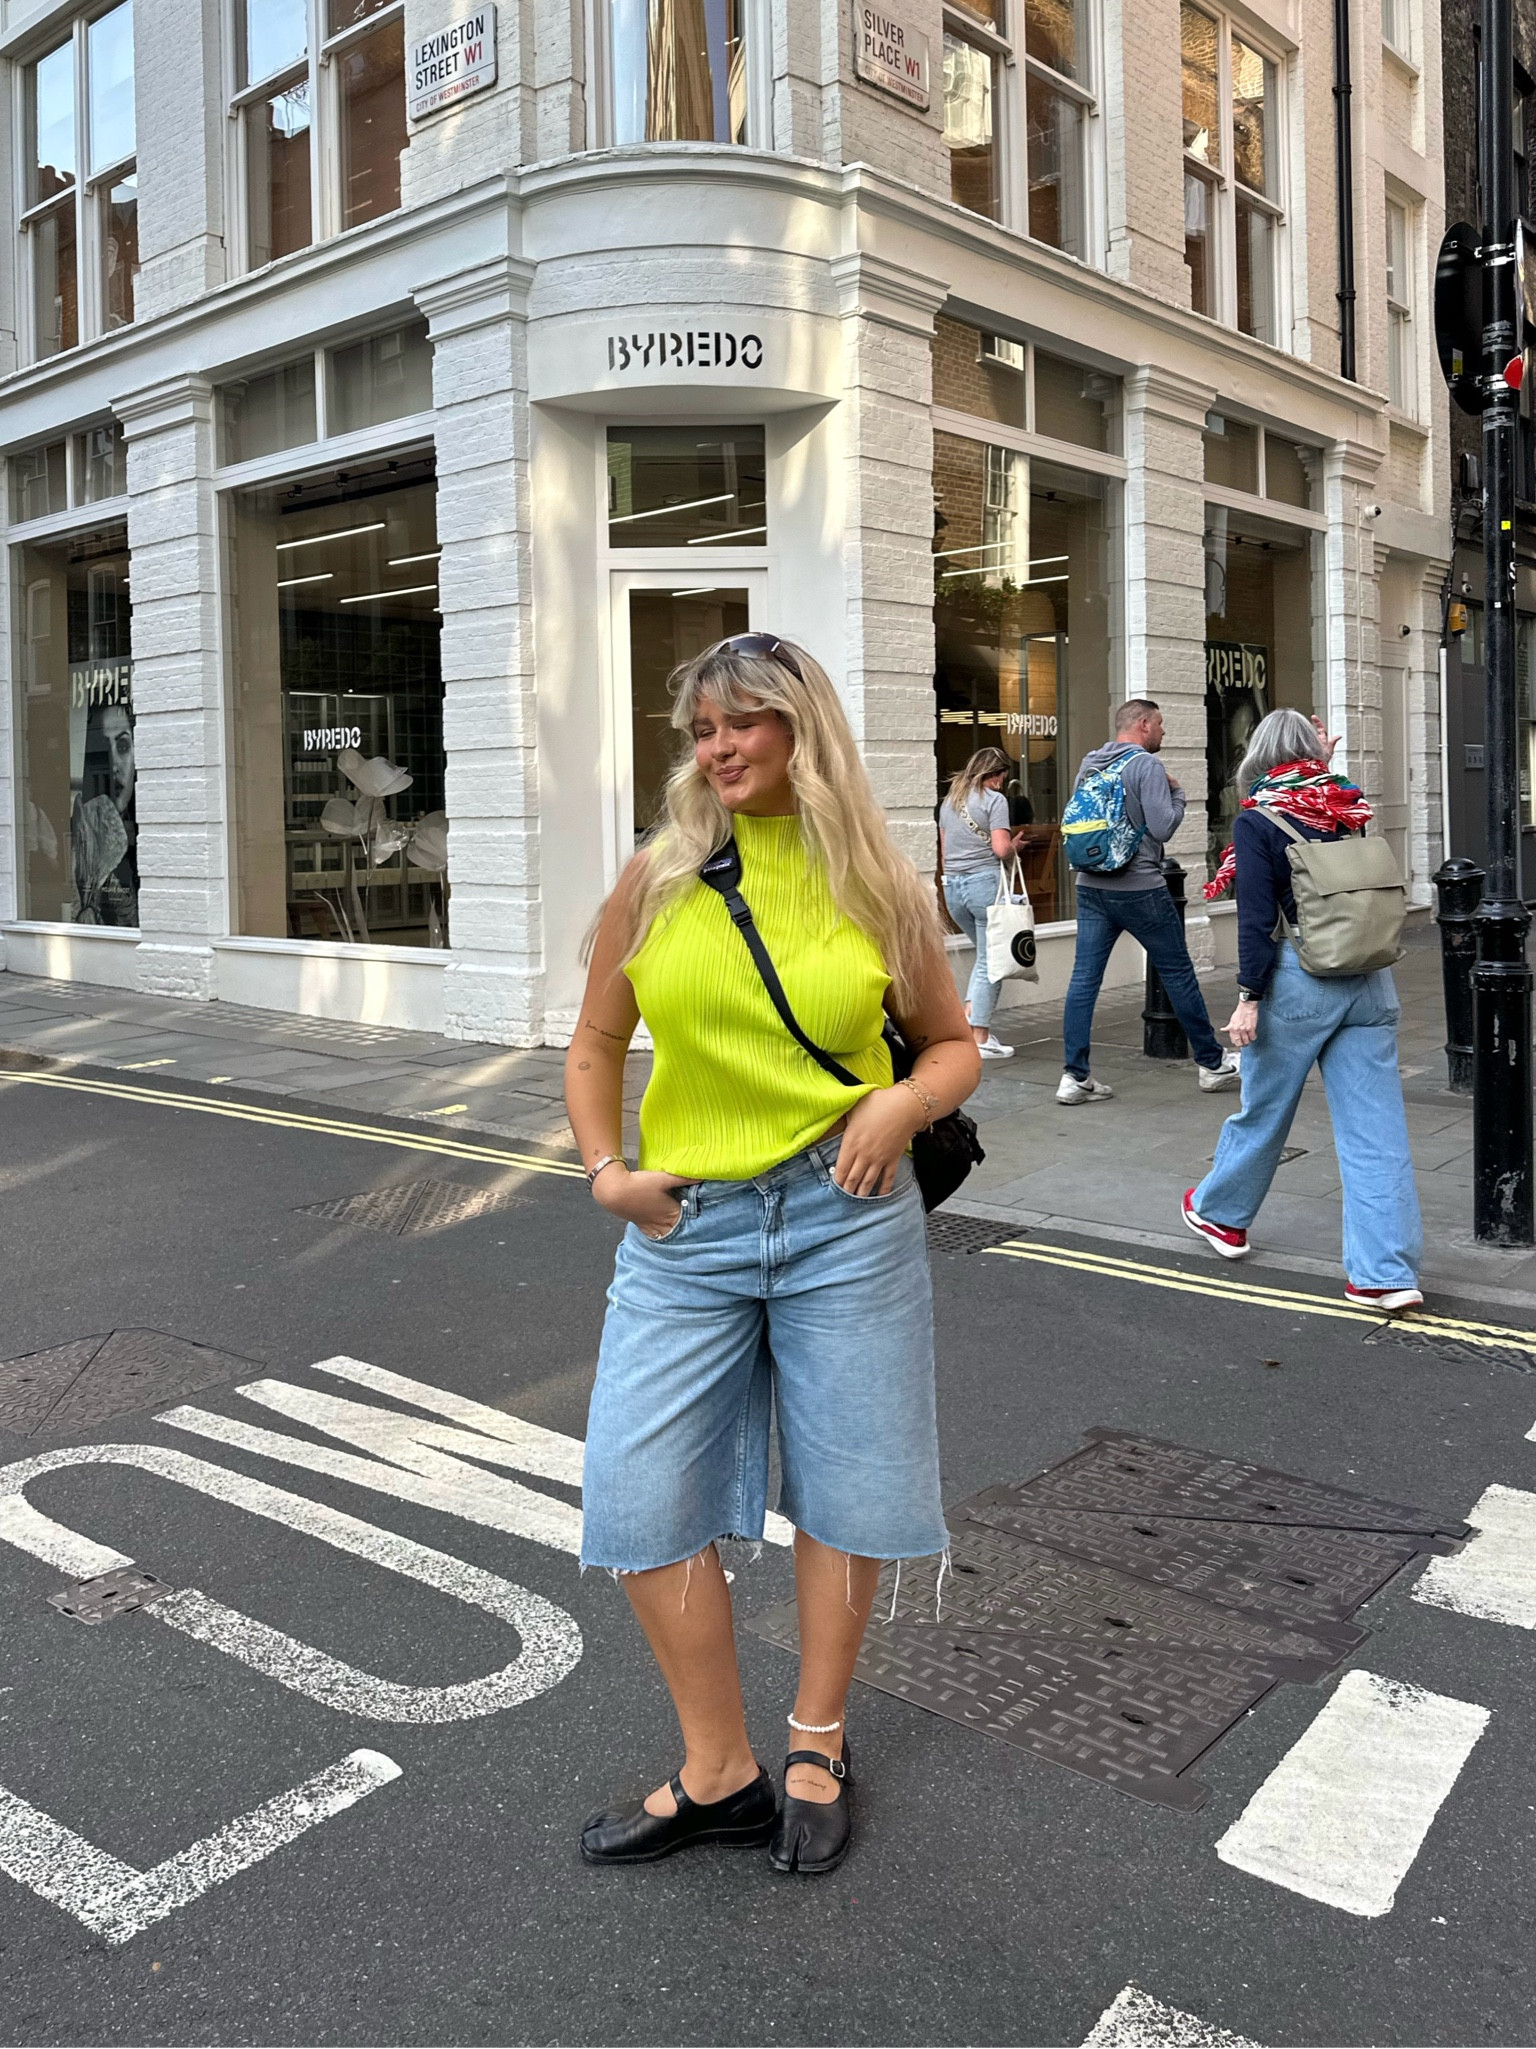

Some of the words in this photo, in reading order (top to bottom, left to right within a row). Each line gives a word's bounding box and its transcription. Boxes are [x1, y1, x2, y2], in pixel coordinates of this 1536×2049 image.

[415, 14, 484, 67] LEXINGTON
[864, 9, 904, 48] SILVER
[415, 51, 460, 91] STREET
[464, 40, 482, 66] W1
[864, 33, 901, 70] PLACE
[904, 54, 920, 81] W1
[416, 99, 428, 112] CITY
[429, 95, 438, 106] OF
[438, 75, 480, 102] WESTMINSTER
[864, 65, 877, 77] CITY
[887, 76, 924, 104] WESTMINSTER
[607, 331, 763, 371] BYREDO
[72, 664, 135, 709] BYRE
[303, 726, 361, 751] BYREDO
[1006, 712, 1058, 736] BYREDO
